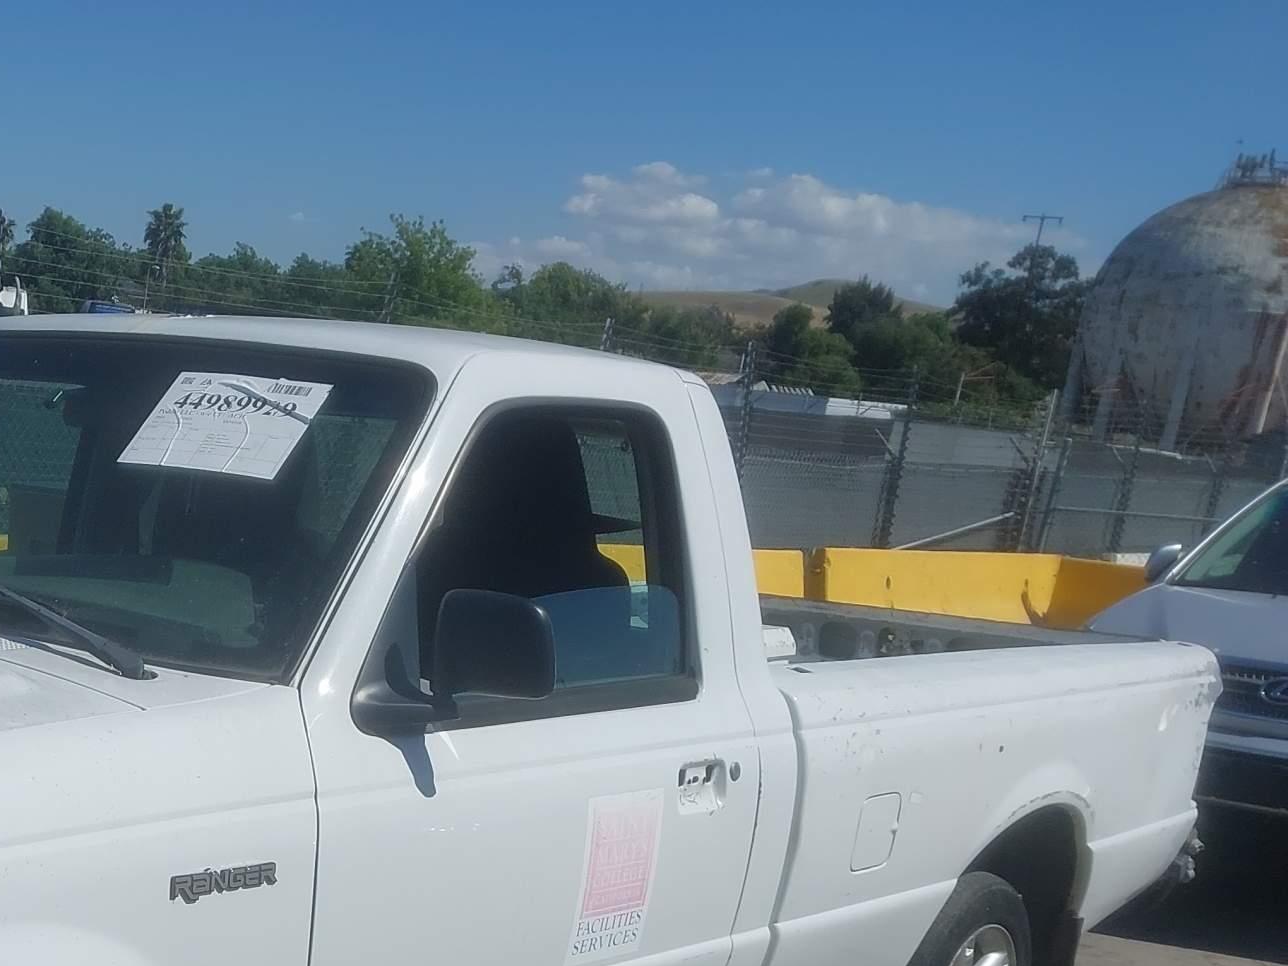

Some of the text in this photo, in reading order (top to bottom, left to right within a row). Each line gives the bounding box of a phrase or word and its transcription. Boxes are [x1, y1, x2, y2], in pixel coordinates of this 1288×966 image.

[169, 861, 278, 905] RANGER
[576, 909, 642, 937] FACILITIES
[571, 927, 639, 956] SERVICES
